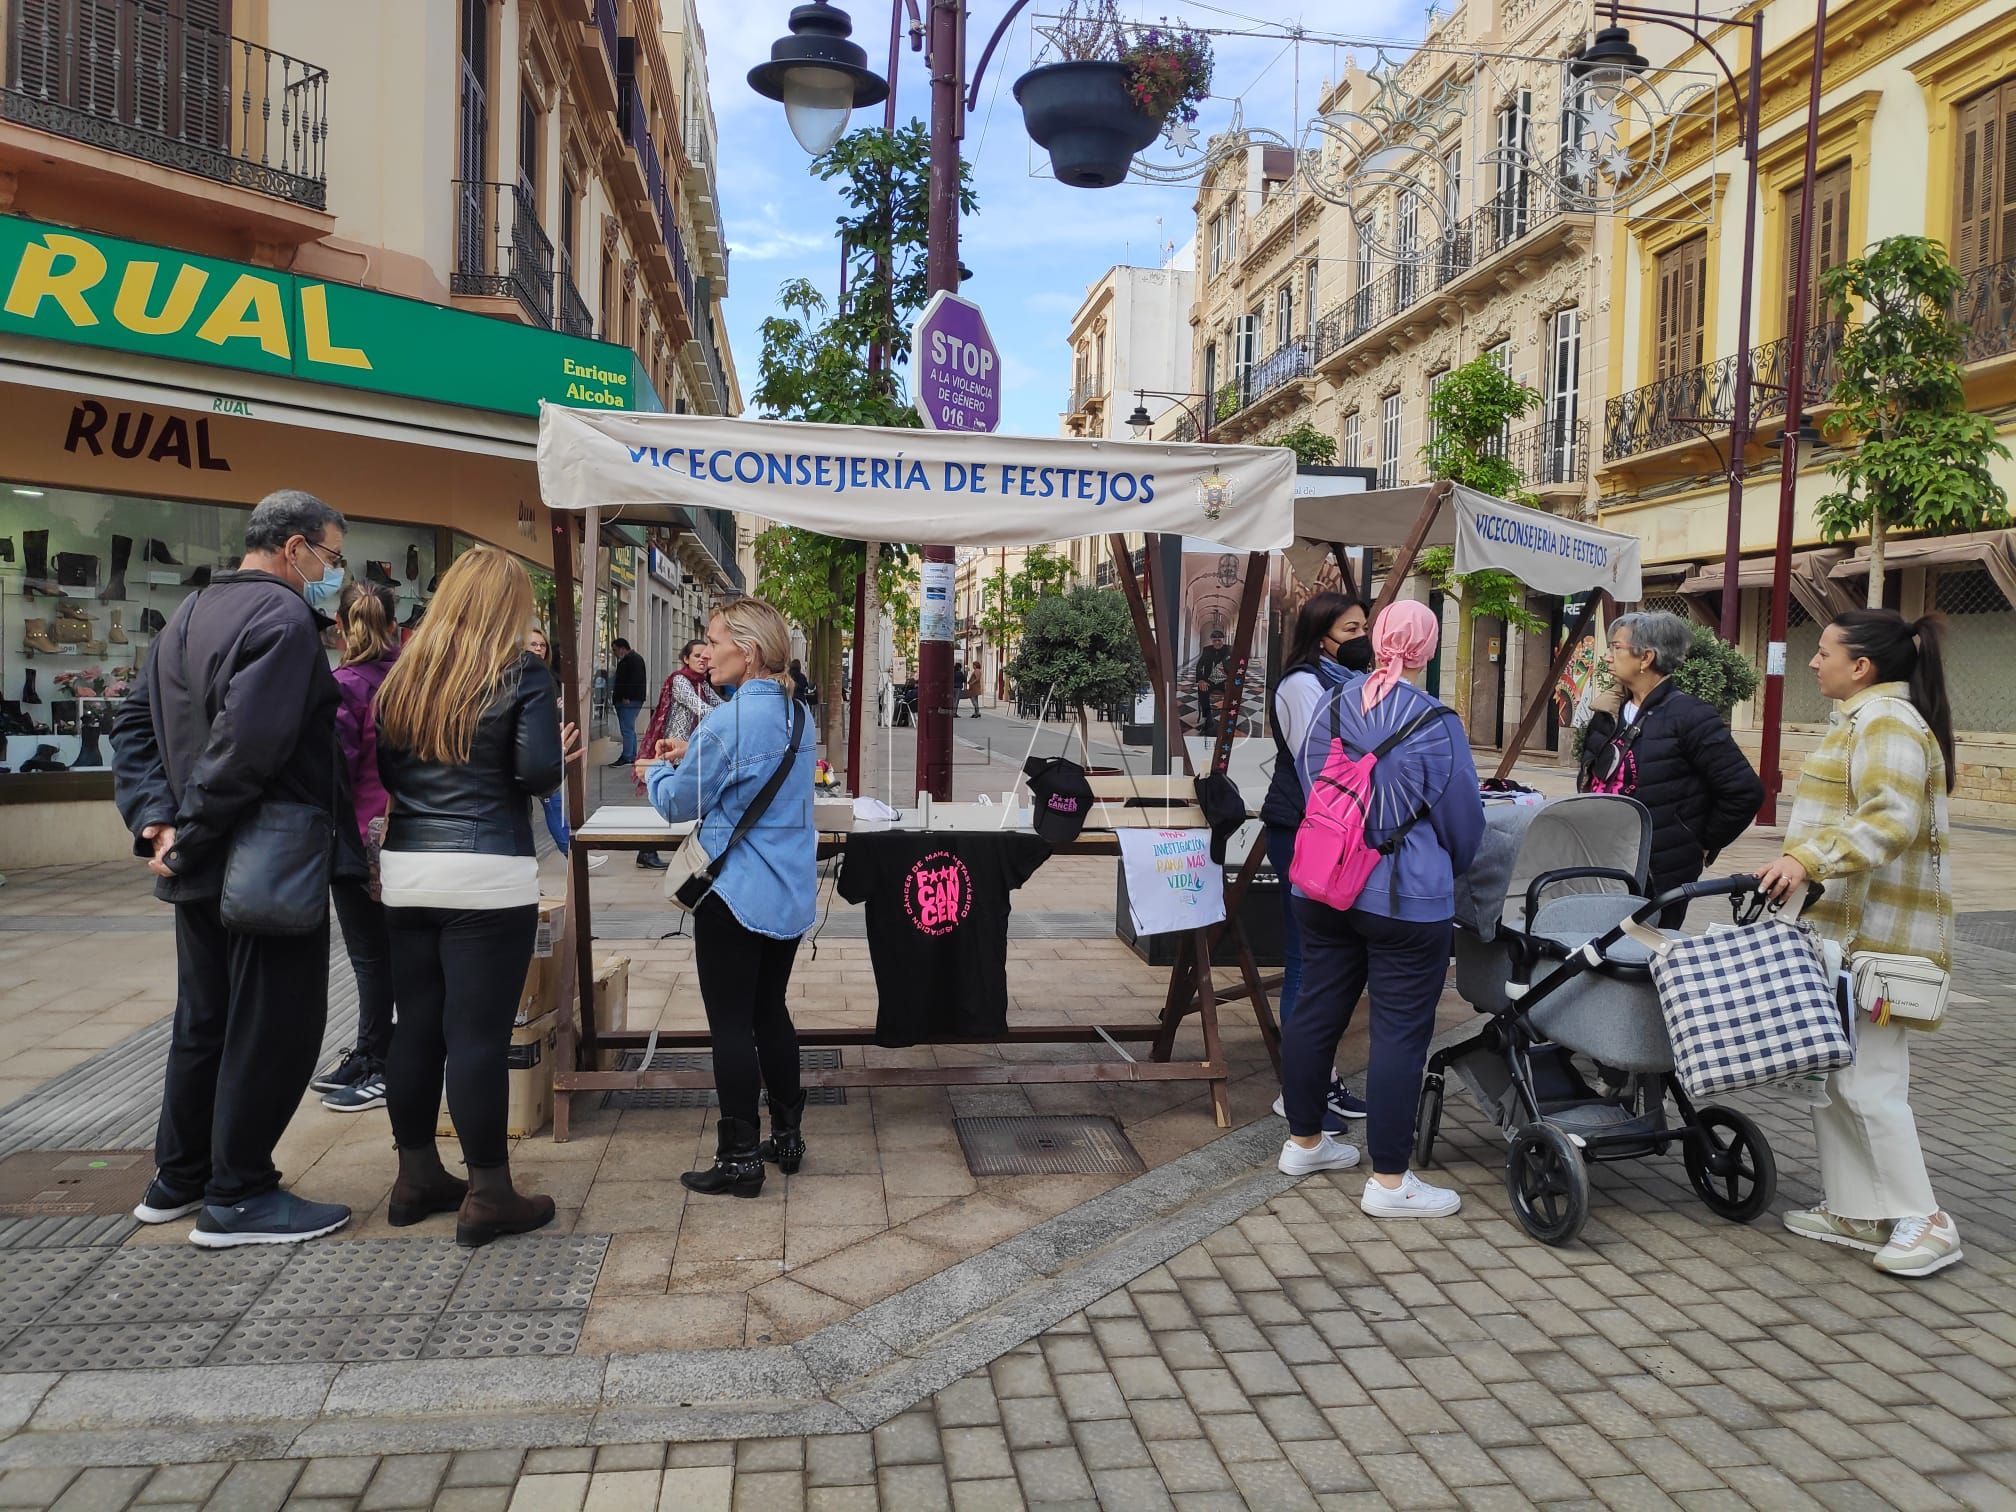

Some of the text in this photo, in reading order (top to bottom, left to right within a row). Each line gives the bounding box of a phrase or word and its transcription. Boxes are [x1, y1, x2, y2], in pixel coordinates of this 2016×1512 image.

[4, 233, 373, 370] RUAL
[931, 330, 993, 380] STOP
[563, 357, 627, 386] Enrique
[930, 368, 993, 400] A LA VIOLENCIA
[213, 398, 253, 416] RUAL
[566, 382, 624, 407] Alcoba
[938, 387, 985, 413] DE GÉNERO
[942, 405, 964, 427] 016
[64, 400, 231, 472] RUAL
[626, 445, 1155, 506] VICECONSEJERÍA DE FESTEJOS
[1560, 534, 1570, 557] DE
[1572, 538, 1608, 568] FESTEJOS
[1048, 799, 1078, 811] CANCER
[1152, 837, 1206, 857] INVESTIGACIÓN
[1156, 852, 1206, 873] PARA MÁS
[904, 874, 913, 915] CÁNCER
[911, 860, 924, 873] DE
[925, 850, 950, 862] MAMA
[917, 880, 960, 906] CAN
[1167, 873, 1194, 889] VIDA
[921, 900, 959, 926] CER
[1889, 999, 1920, 1008] ALENTINO
